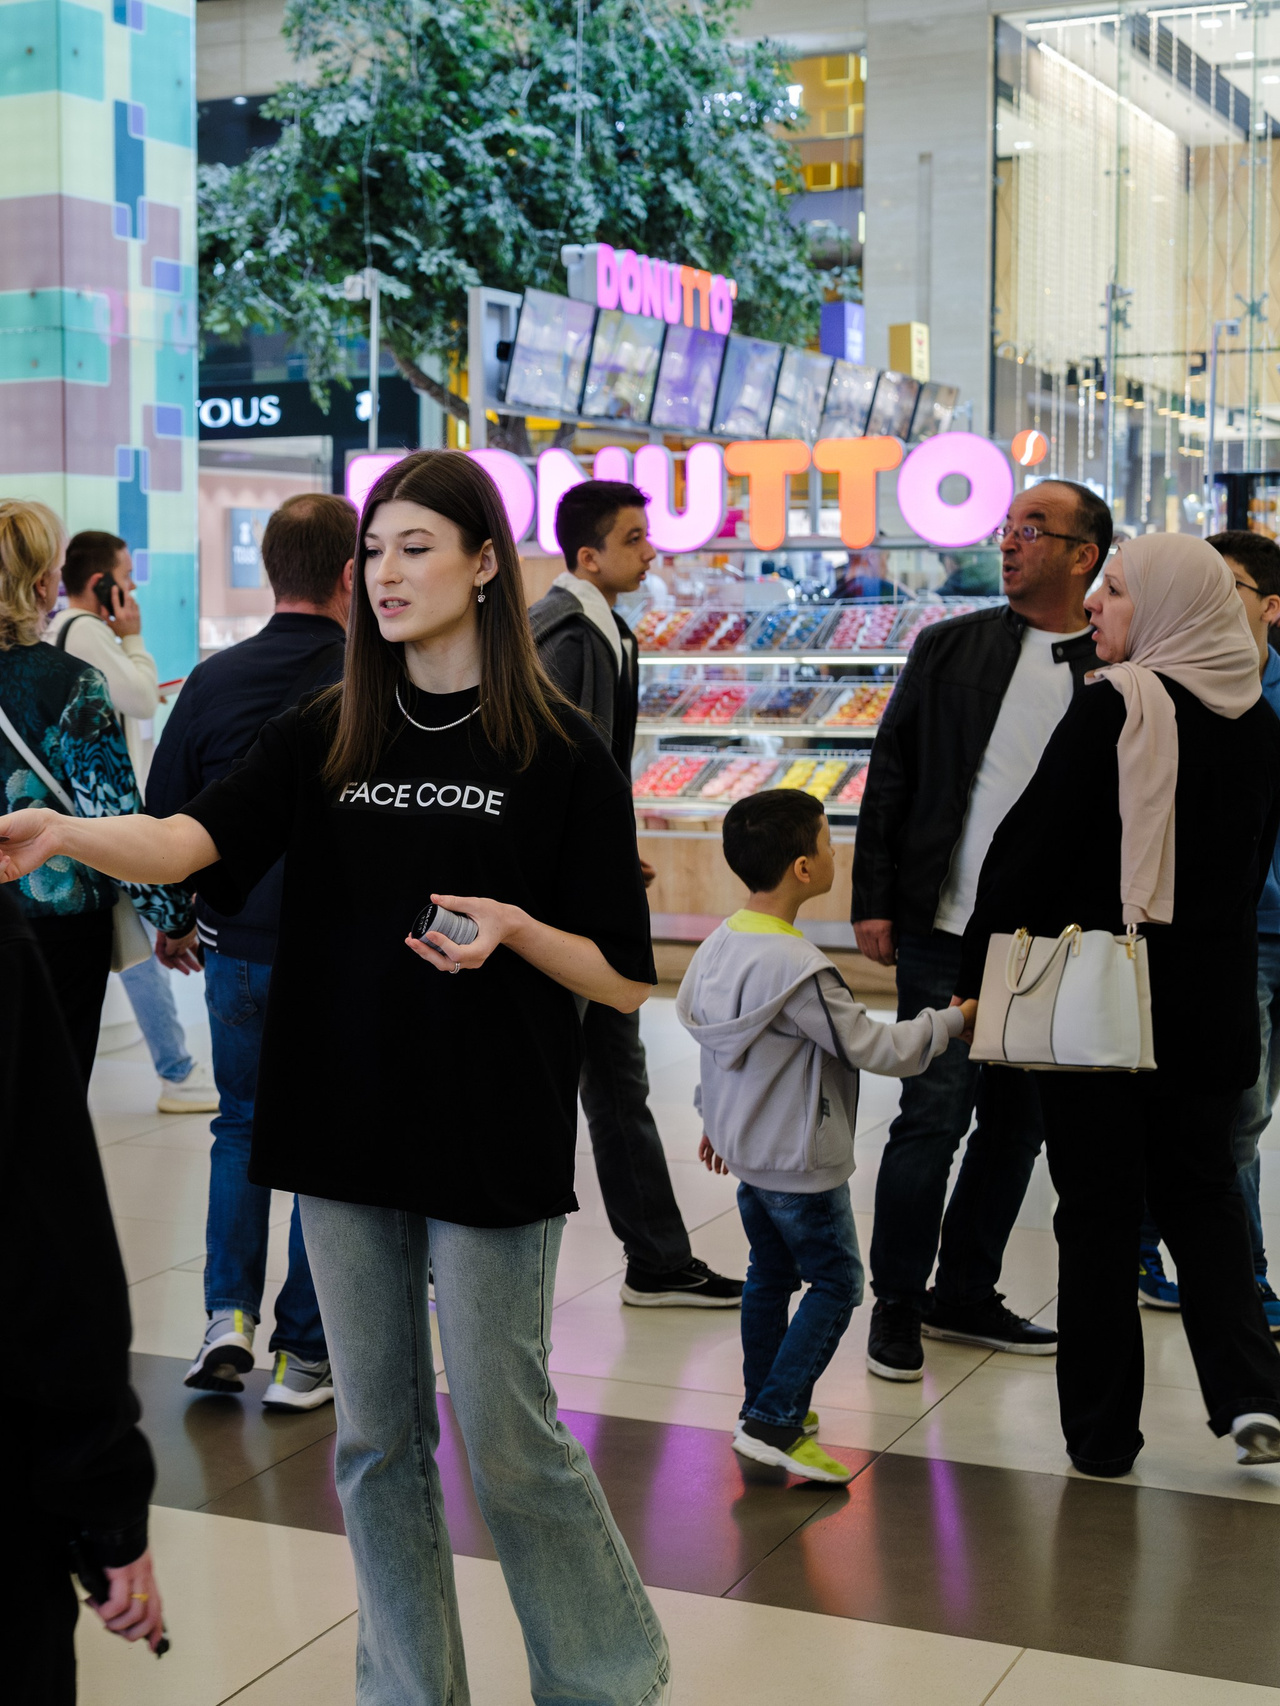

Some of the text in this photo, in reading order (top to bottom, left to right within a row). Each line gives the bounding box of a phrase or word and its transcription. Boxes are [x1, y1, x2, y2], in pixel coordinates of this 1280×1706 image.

[596, 242, 733, 336] DONUTTO
[195, 395, 282, 428] OUS
[339, 781, 505, 816] FACE CODE
